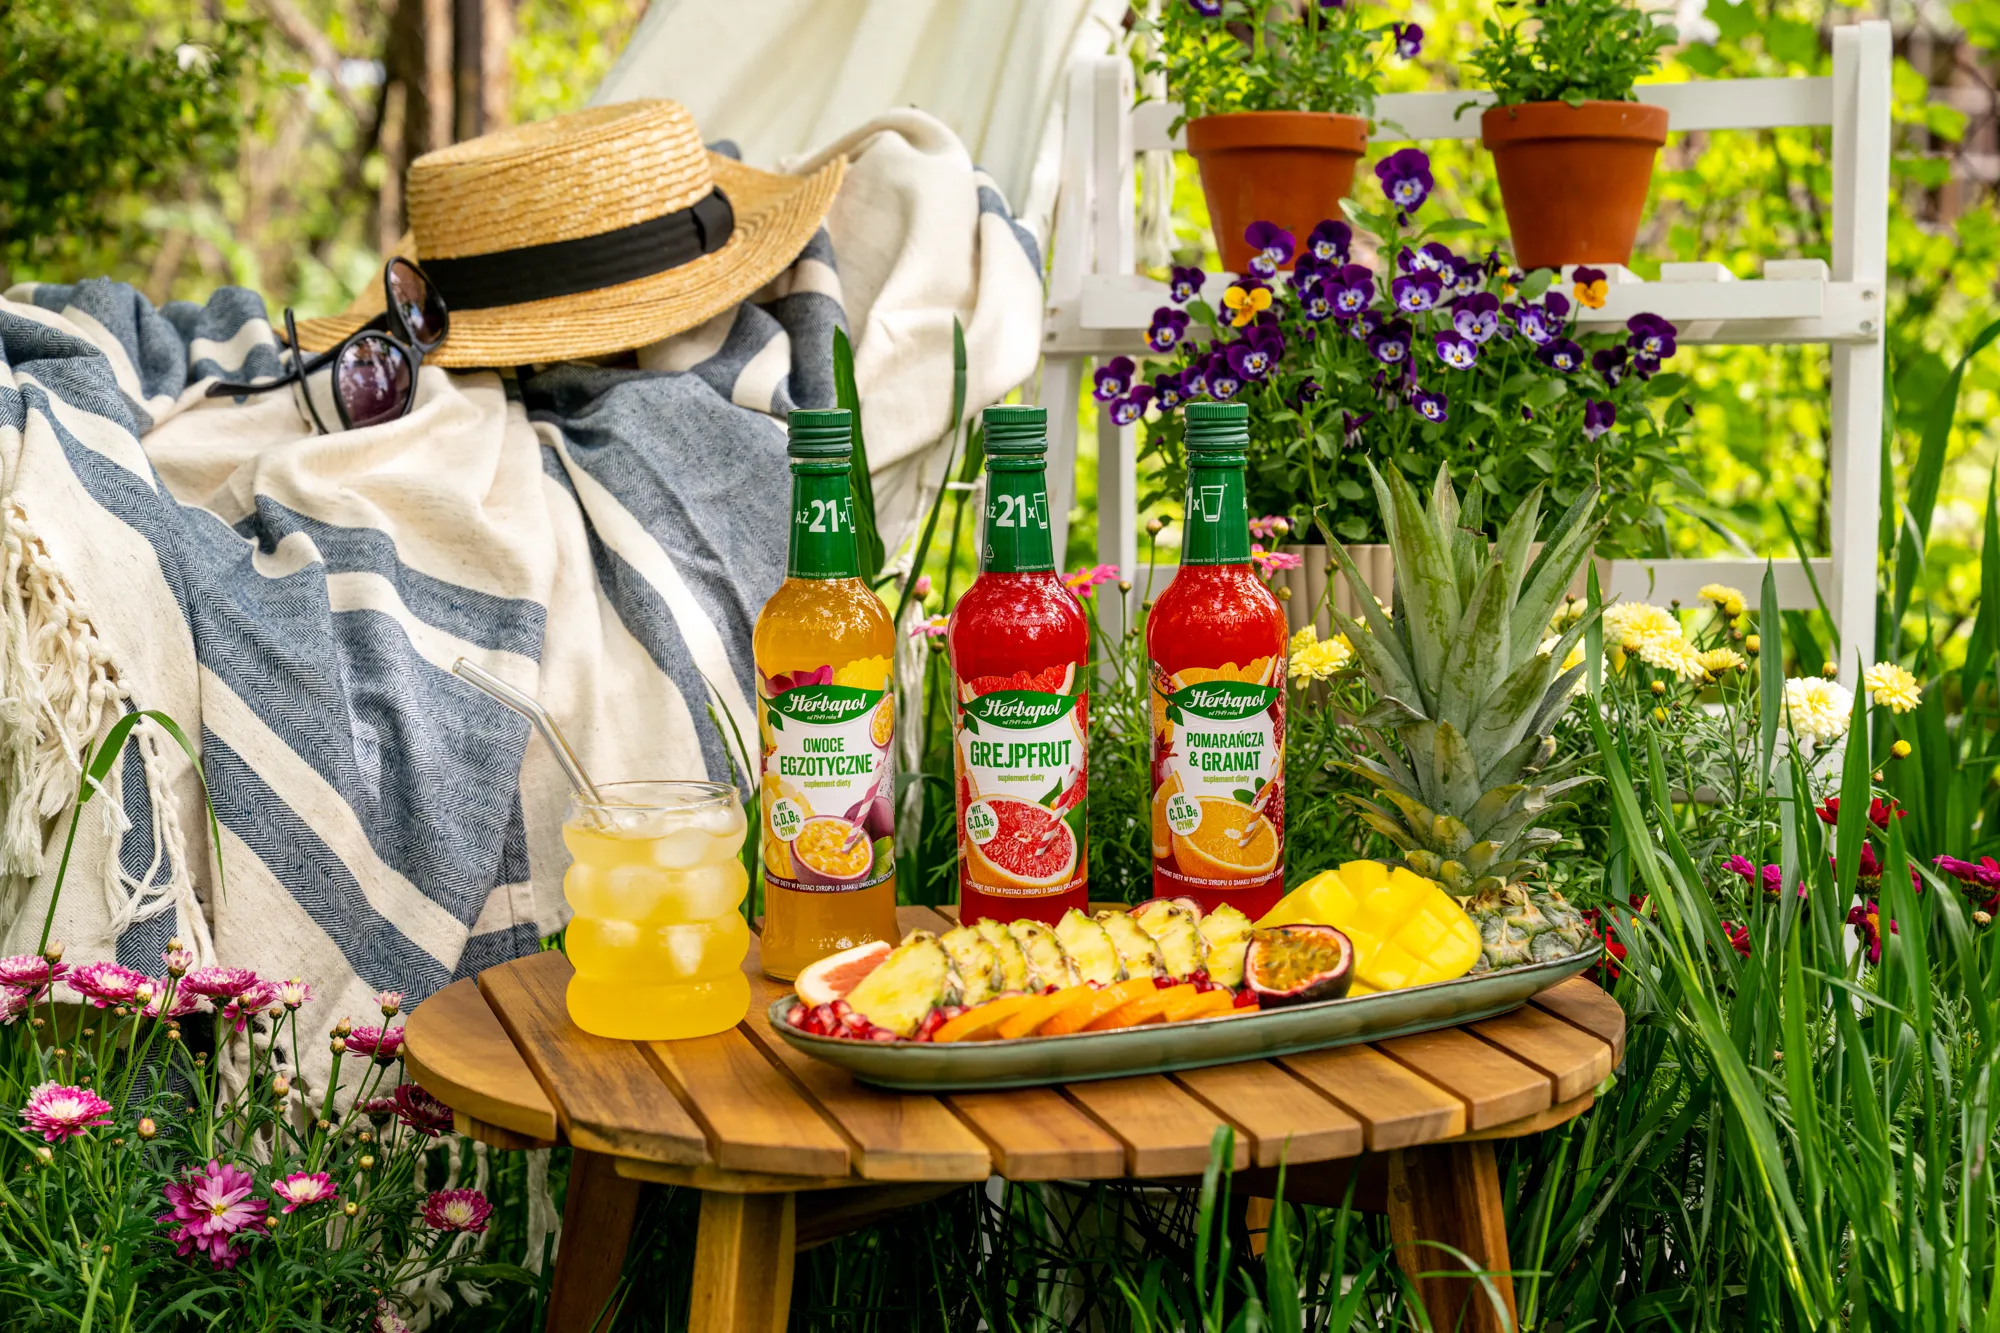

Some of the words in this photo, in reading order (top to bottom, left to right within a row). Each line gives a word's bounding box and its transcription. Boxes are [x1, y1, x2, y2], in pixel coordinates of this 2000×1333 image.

[795, 508, 809, 524] AŻ
[985, 502, 996, 519] AŻ
[784, 693, 866, 718] Herbapol
[1184, 689, 1265, 714] Herbapol
[980, 697, 1061, 723] Herbapol
[803, 737, 844, 753] OWOCE
[1186, 730, 1264, 748] POMARAŃCZA
[970, 740, 1072, 768] GREJPFRUT
[780, 754, 872, 776] EGZOTYCZNE
[1189, 751, 1199, 767] &
[1202, 751, 1261, 772] GRANAT
[804, 780, 835, 789] suplement
[836, 780, 851, 788] diety
[997, 774, 1029, 783] suplement
[1030, 773, 1044, 782] diety
[1203, 775, 1235, 784] suplement
[1236, 774, 1249, 783] diety
[776, 801, 789, 812] WIT.
[1173, 796, 1186, 806] WIT.
[971, 805, 983, 815] WIT.
[780, 824, 797, 837] CYNK
[1176, 819, 1194, 831] CYNK
[974, 828, 991, 840] CYNK
[780, 880, 791, 888] DIETY
[1173, 872, 1183, 881] DIETY
[1189, 877, 1207, 885] POSTACI
[984, 885, 996, 893] DIETY
